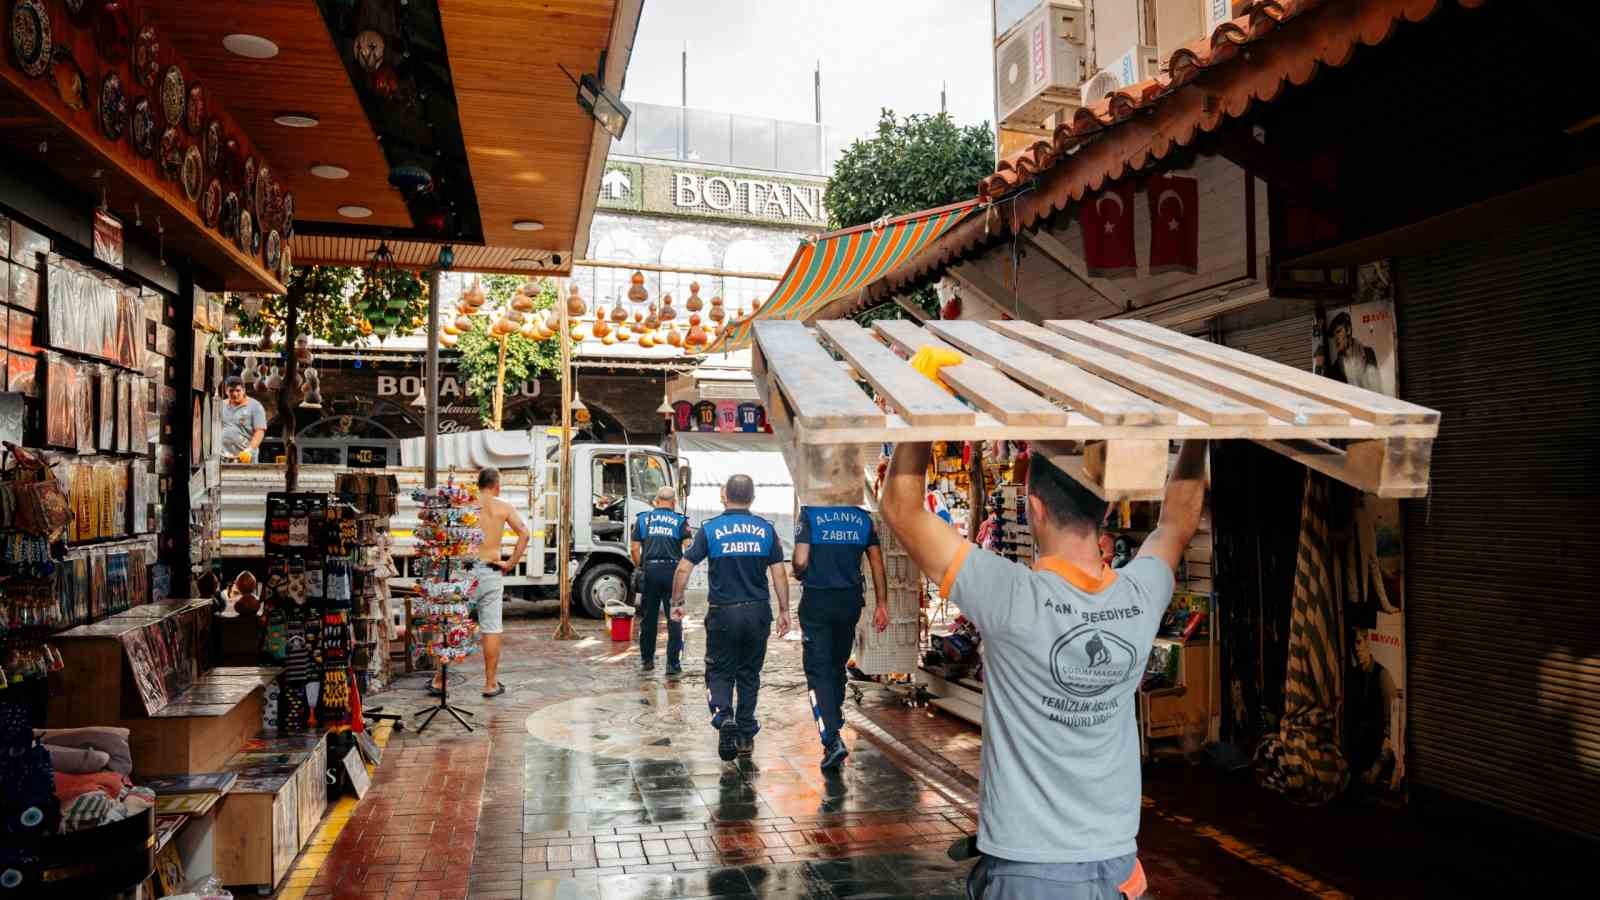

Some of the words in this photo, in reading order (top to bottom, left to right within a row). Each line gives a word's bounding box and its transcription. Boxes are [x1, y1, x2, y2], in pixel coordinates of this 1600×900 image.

[701, 410, 713, 424] 10
[814, 512, 864, 527] ALANYA
[714, 523, 767, 540] ALANYA
[821, 529, 860, 542] ZABITA
[721, 541, 761, 554] ZABITA
